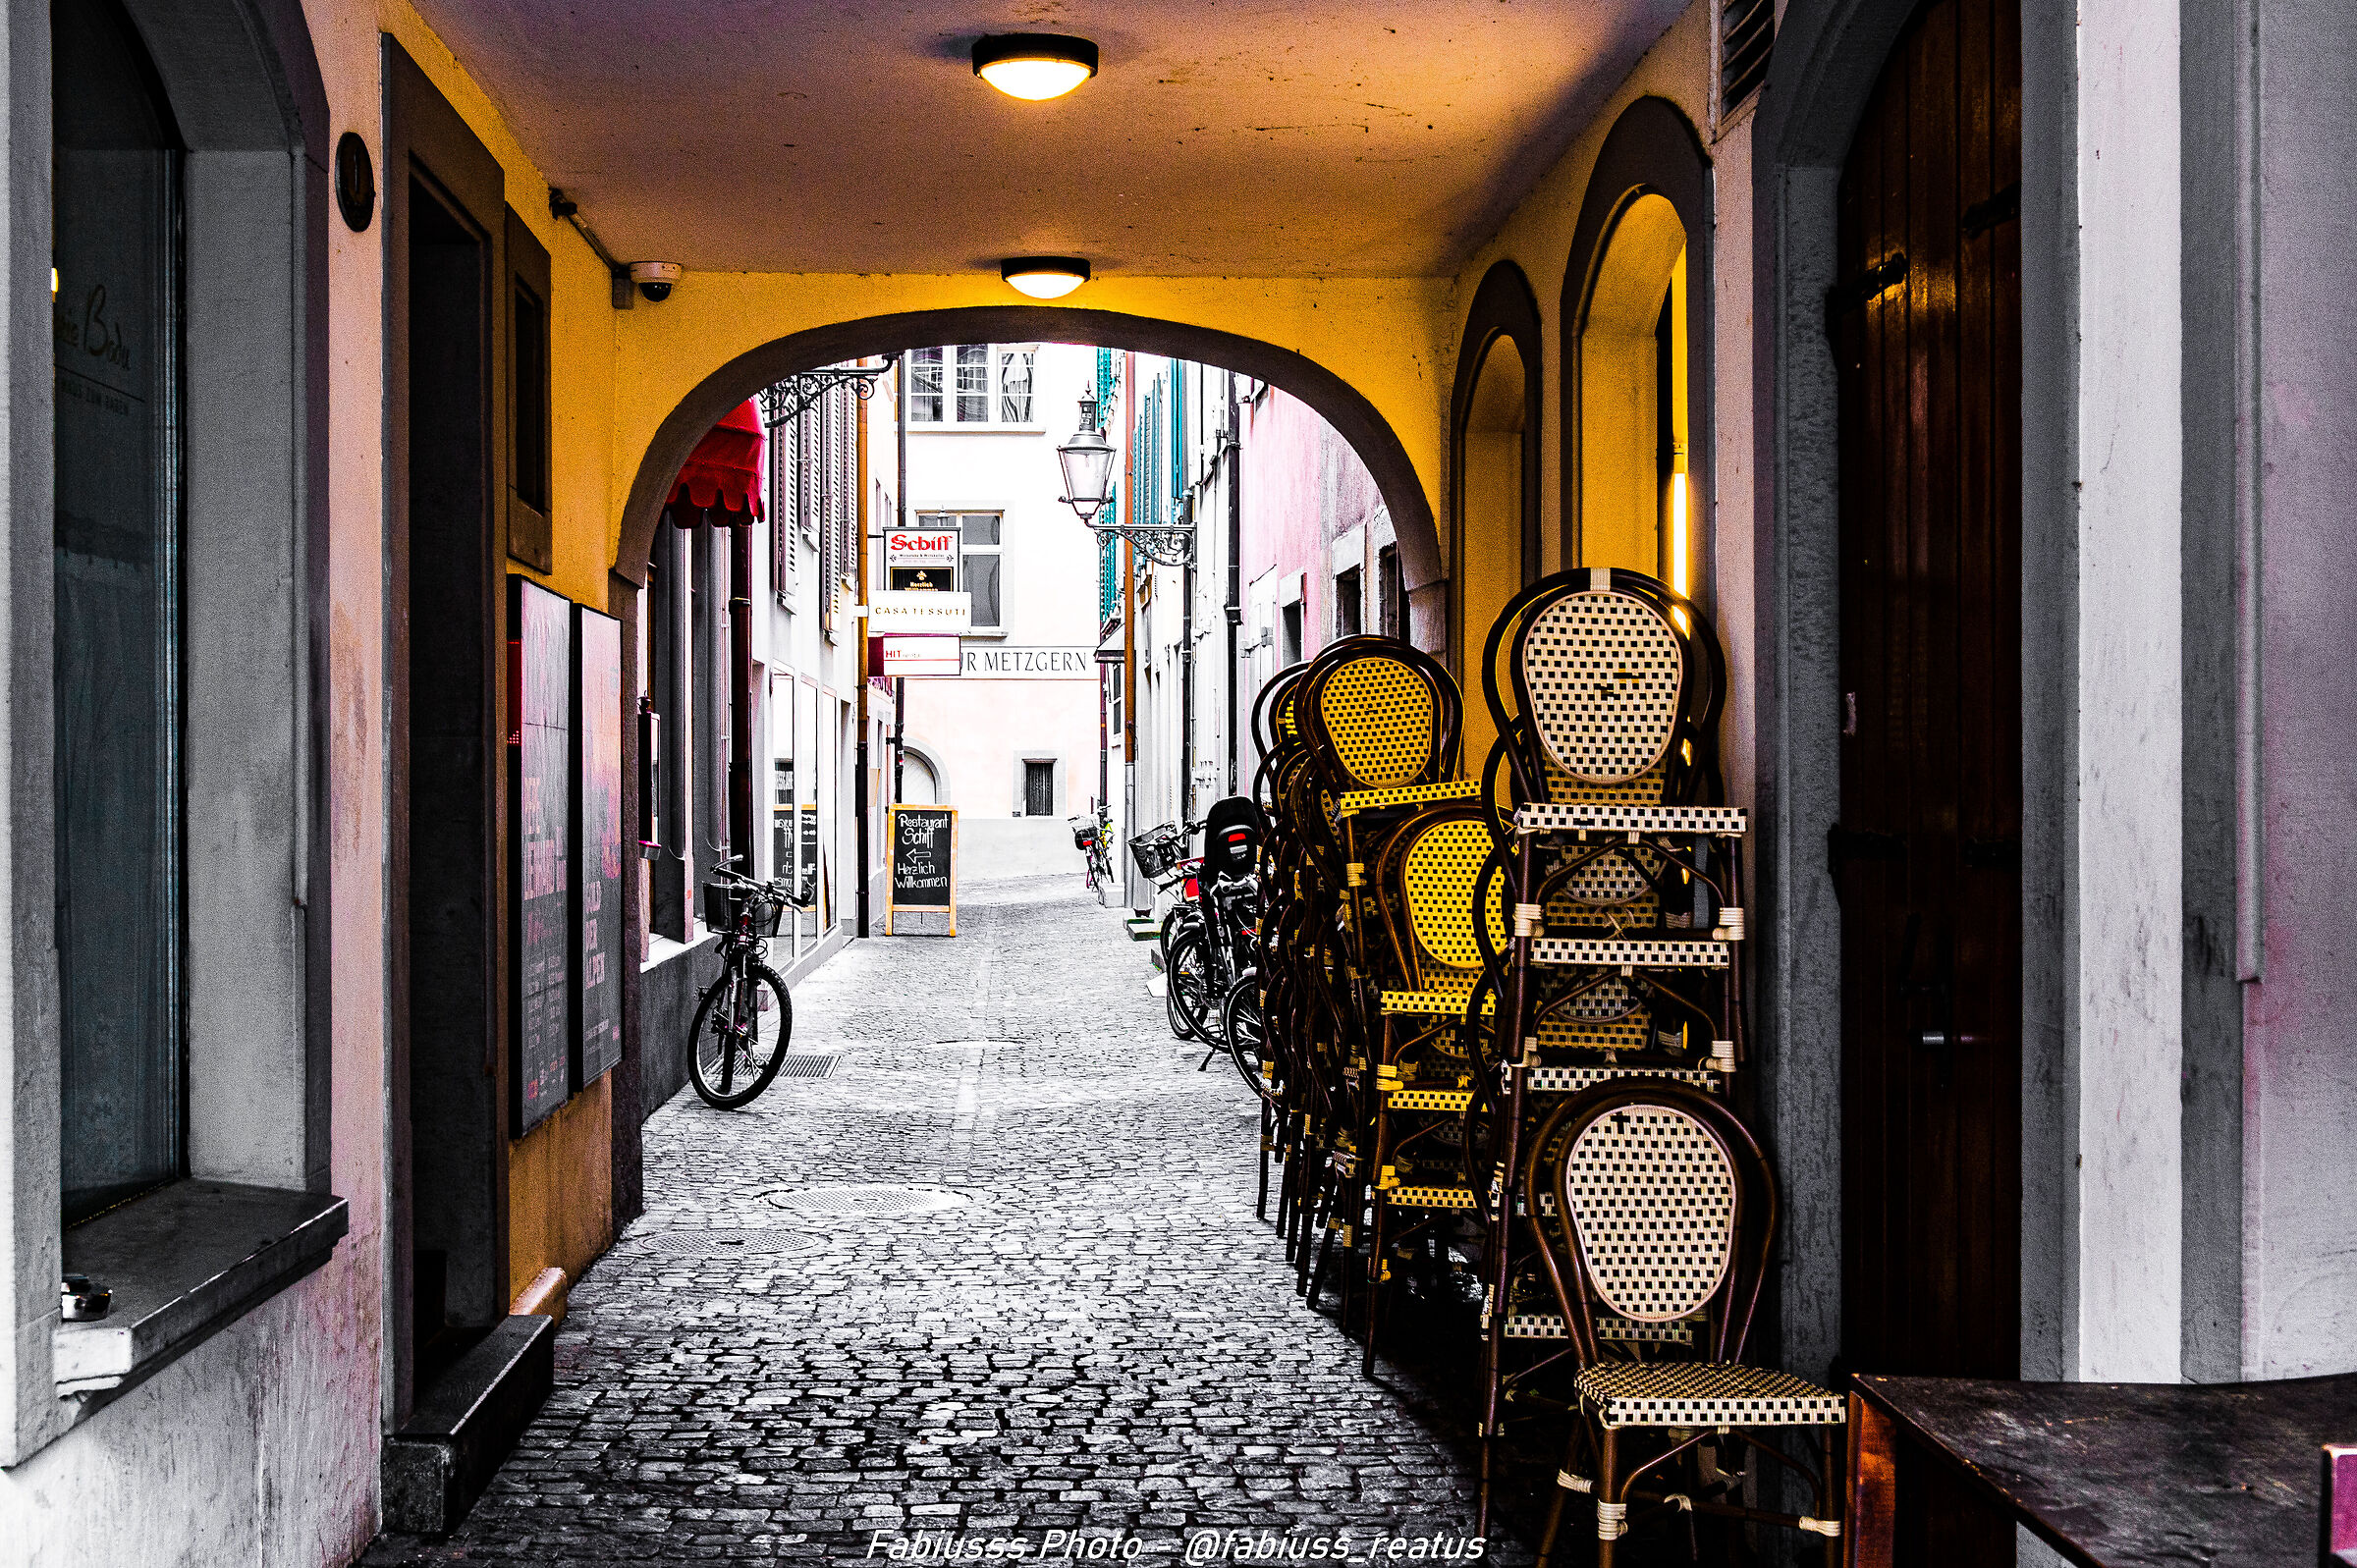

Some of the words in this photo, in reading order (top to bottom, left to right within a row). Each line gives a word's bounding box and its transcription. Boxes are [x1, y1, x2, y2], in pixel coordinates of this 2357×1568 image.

[984, 652, 1088, 672] METZGERN
[898, 813, 949, 829] Restaurant
[902, 827, 935, 849] Schiff
[897, 861, 936, 875] Herzlich
